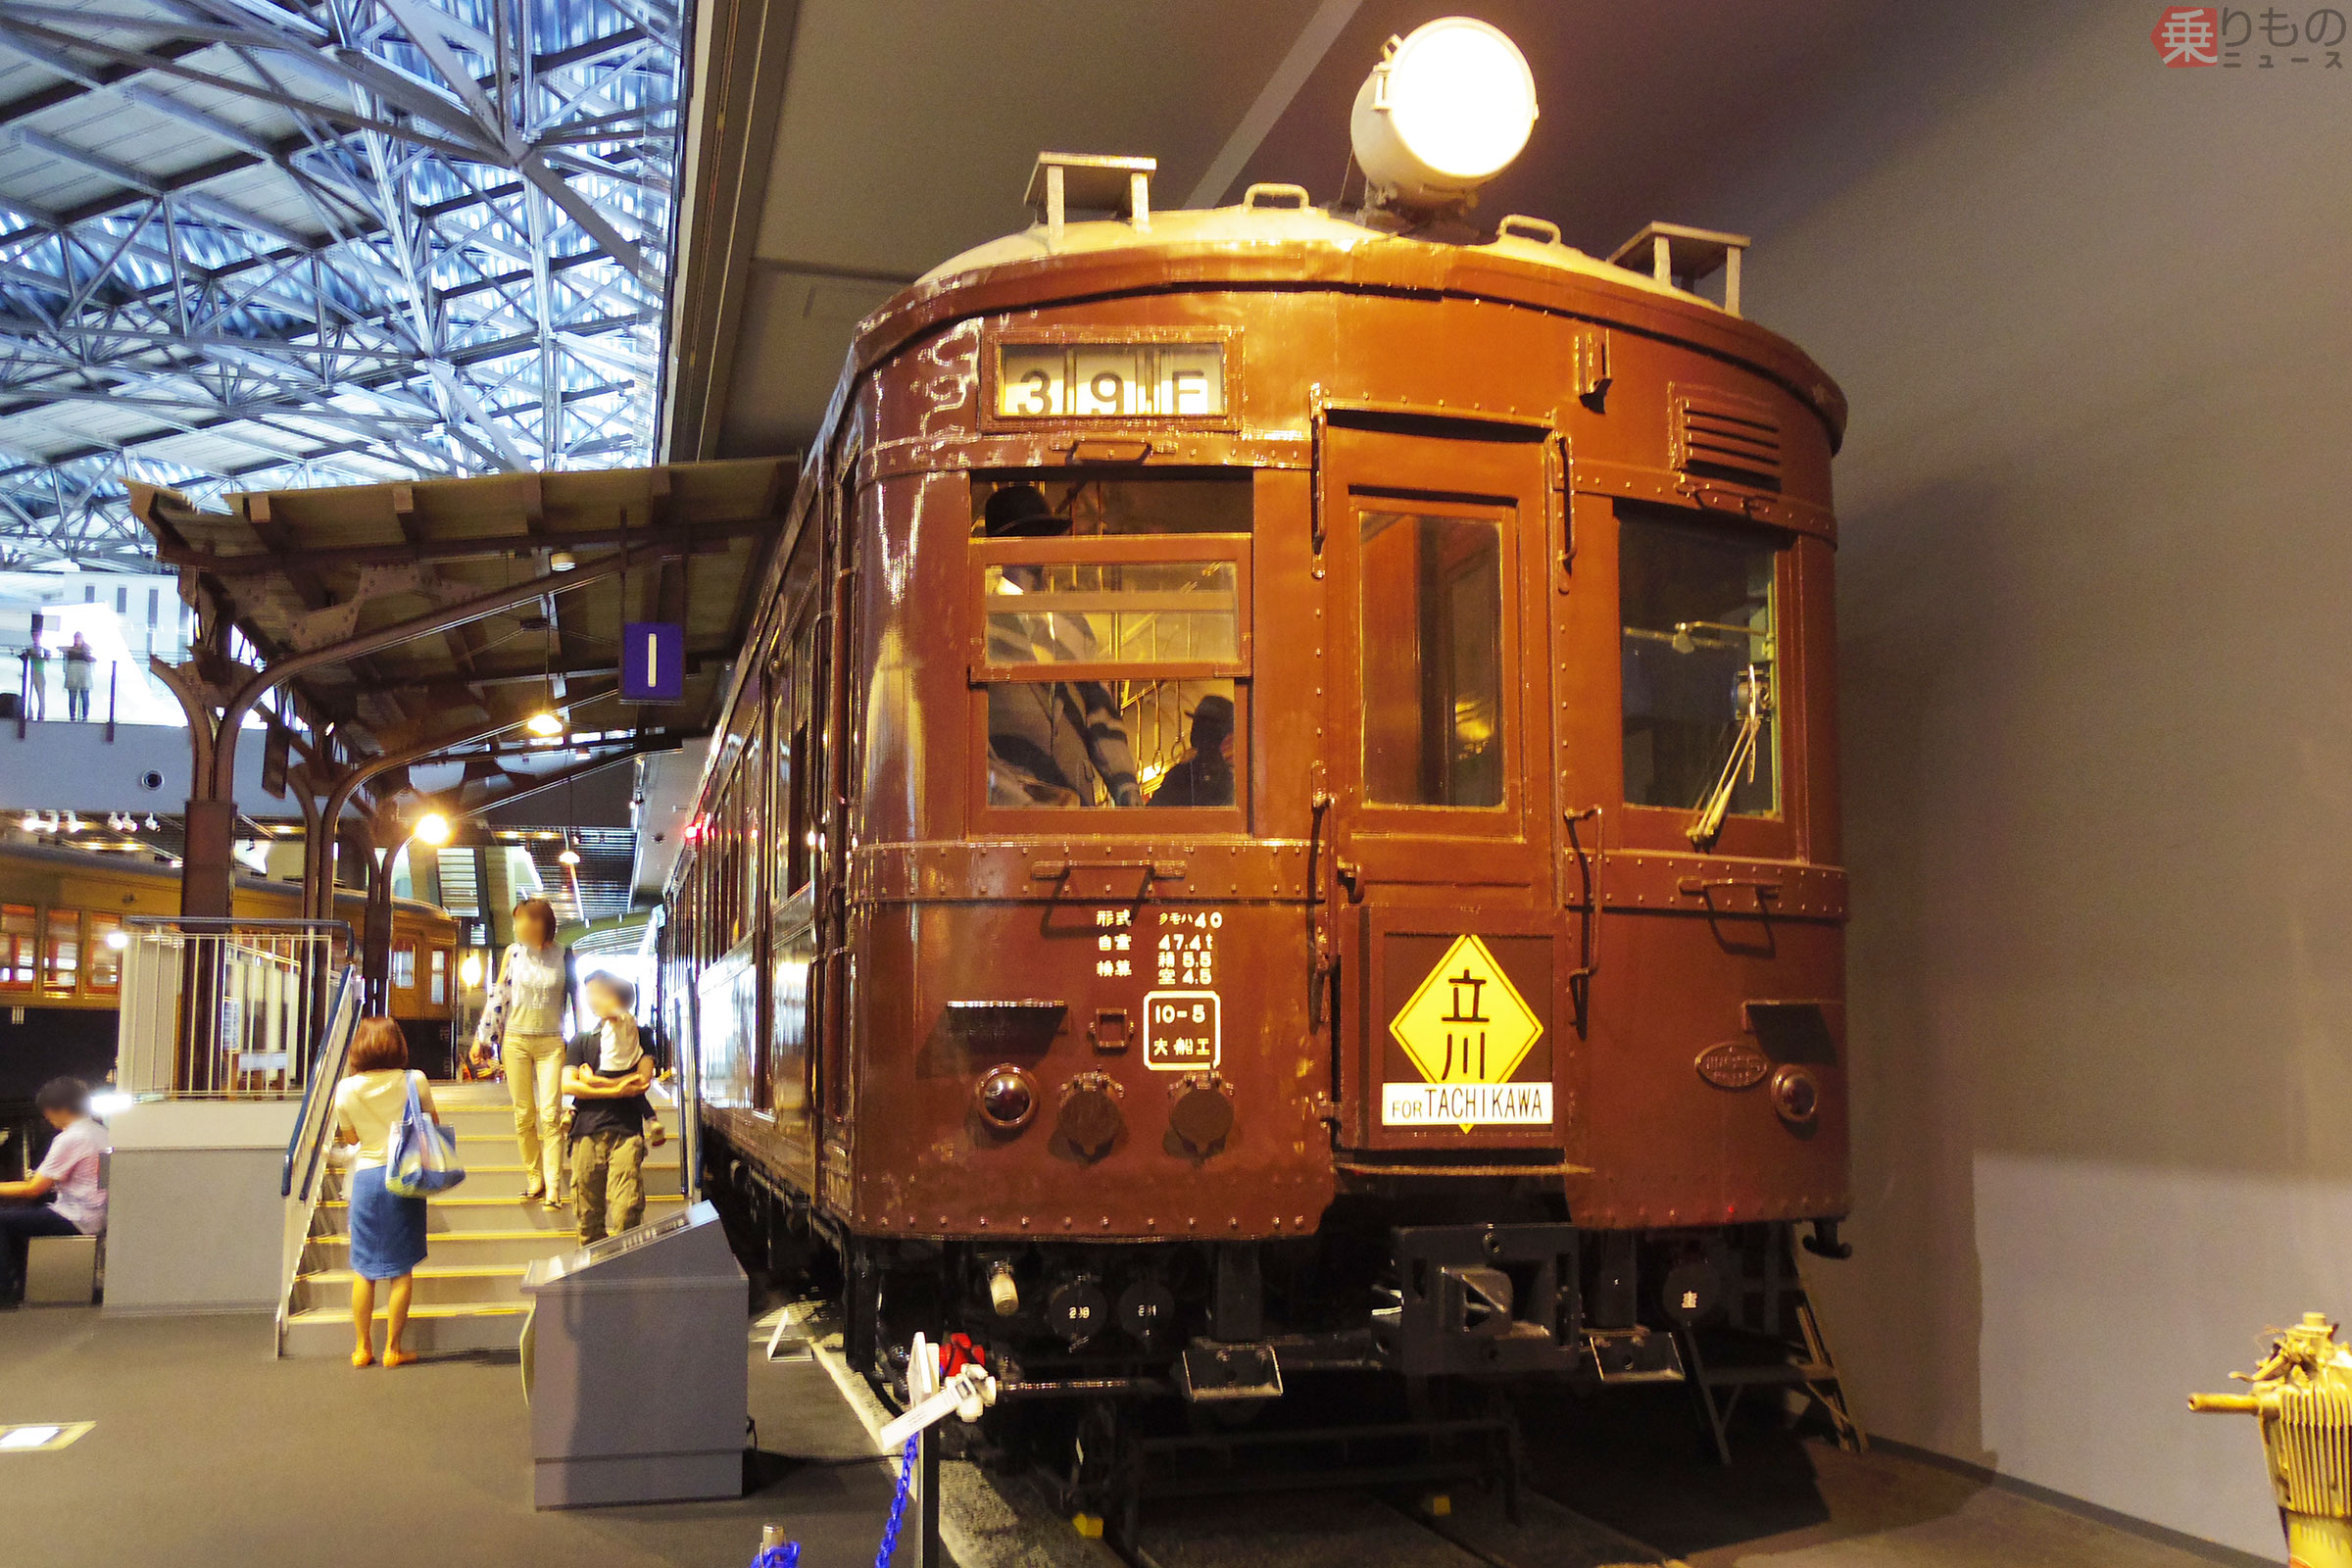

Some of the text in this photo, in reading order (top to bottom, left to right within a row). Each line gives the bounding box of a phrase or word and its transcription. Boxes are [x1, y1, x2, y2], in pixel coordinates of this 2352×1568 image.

[1096, 909, 1132, 927] 形式
[1157, 968, 1176, 985] 空
[1155, 1004, 1206, 1024] 10-5
[1442, 969, 1490, 1081] 立川
[1153, 1037, 1210, 1056] 大船工
[1392, 1087, 1543, 1118] FOR TACHIKAWA
